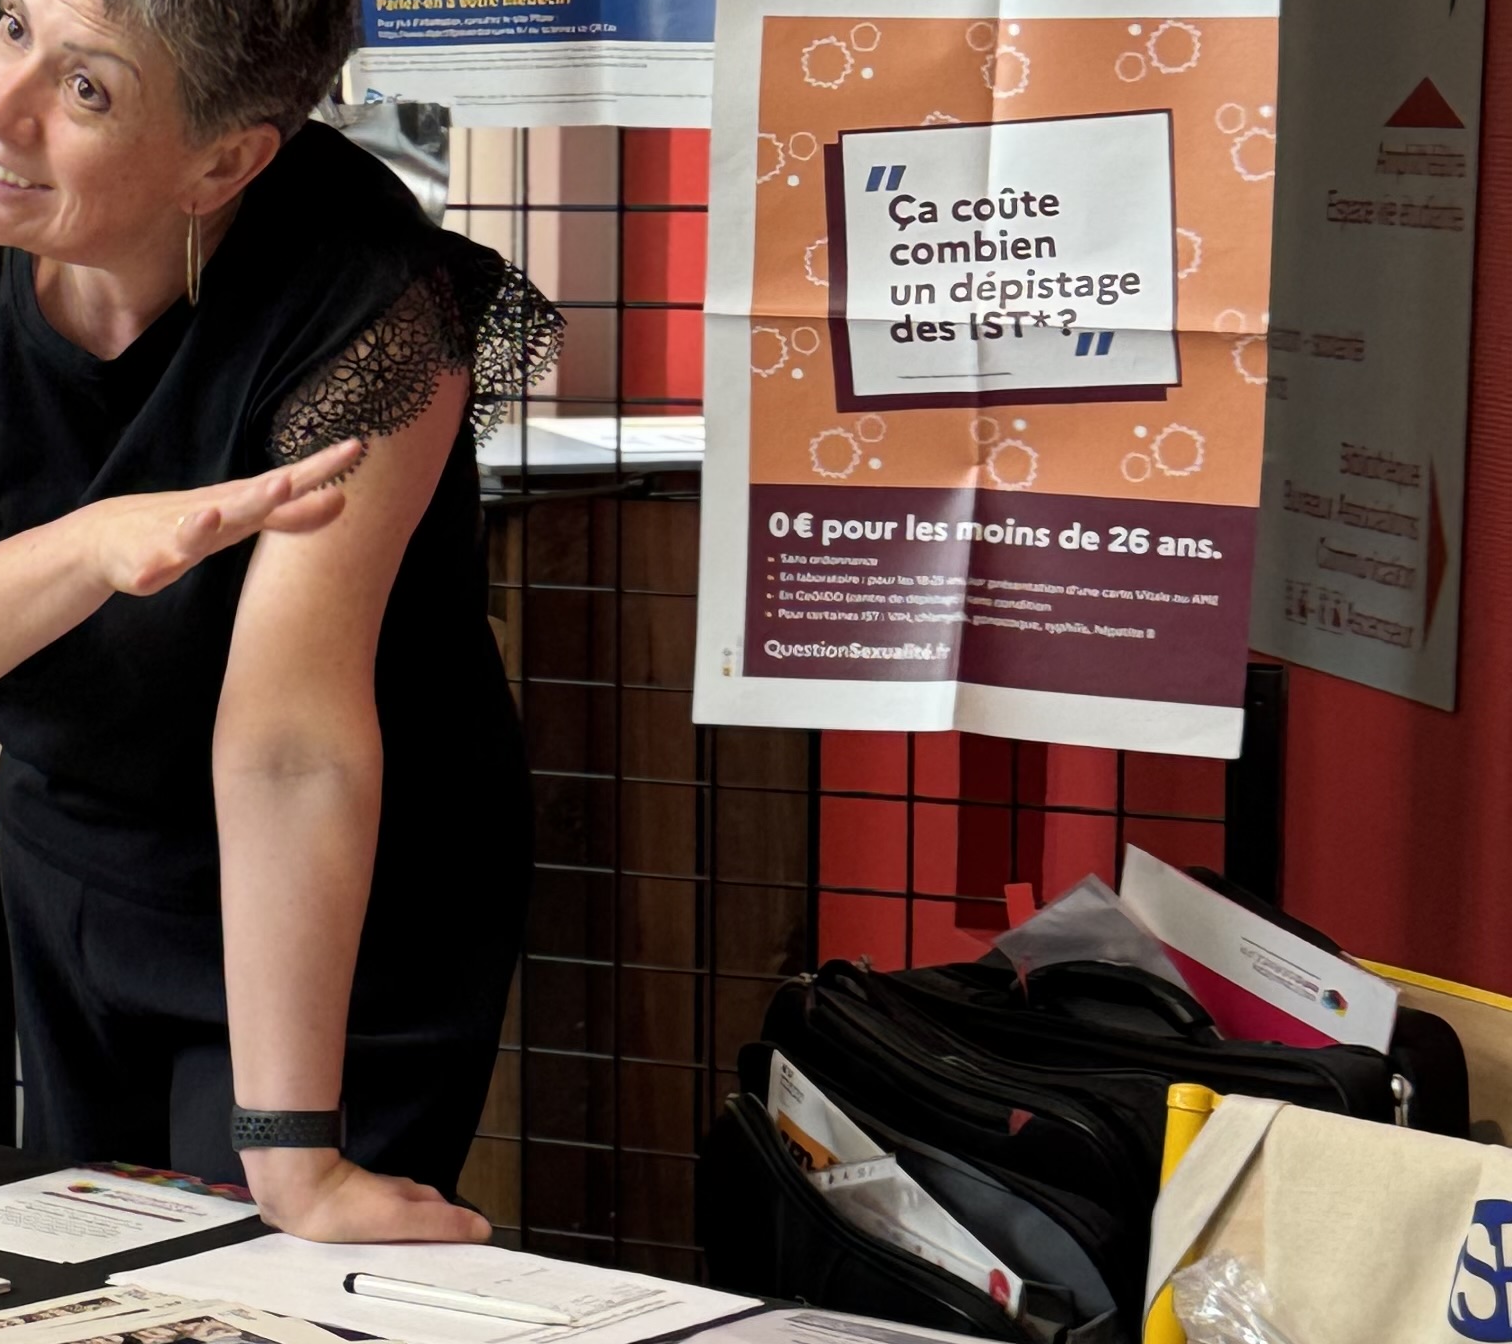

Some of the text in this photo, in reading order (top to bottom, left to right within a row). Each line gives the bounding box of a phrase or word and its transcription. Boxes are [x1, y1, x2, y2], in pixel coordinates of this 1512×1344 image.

[888, 187, 1061, 231] Ça coûte
[889, 231, 1057, 267] combien
[890, 267, 1141, 309] un dépistage
[890, 314, 956, 344] des
[1057, 308, 1078, 338] ?
[822, 514, 897, 546] pour
[906, 513, 948, 541] les
[957, 518, 1051, 549] moins
[1059, 522, 1100, 552] de
[1107, 525, 1150, 554] 26
[1157, 535, 1223, 560] ans.
